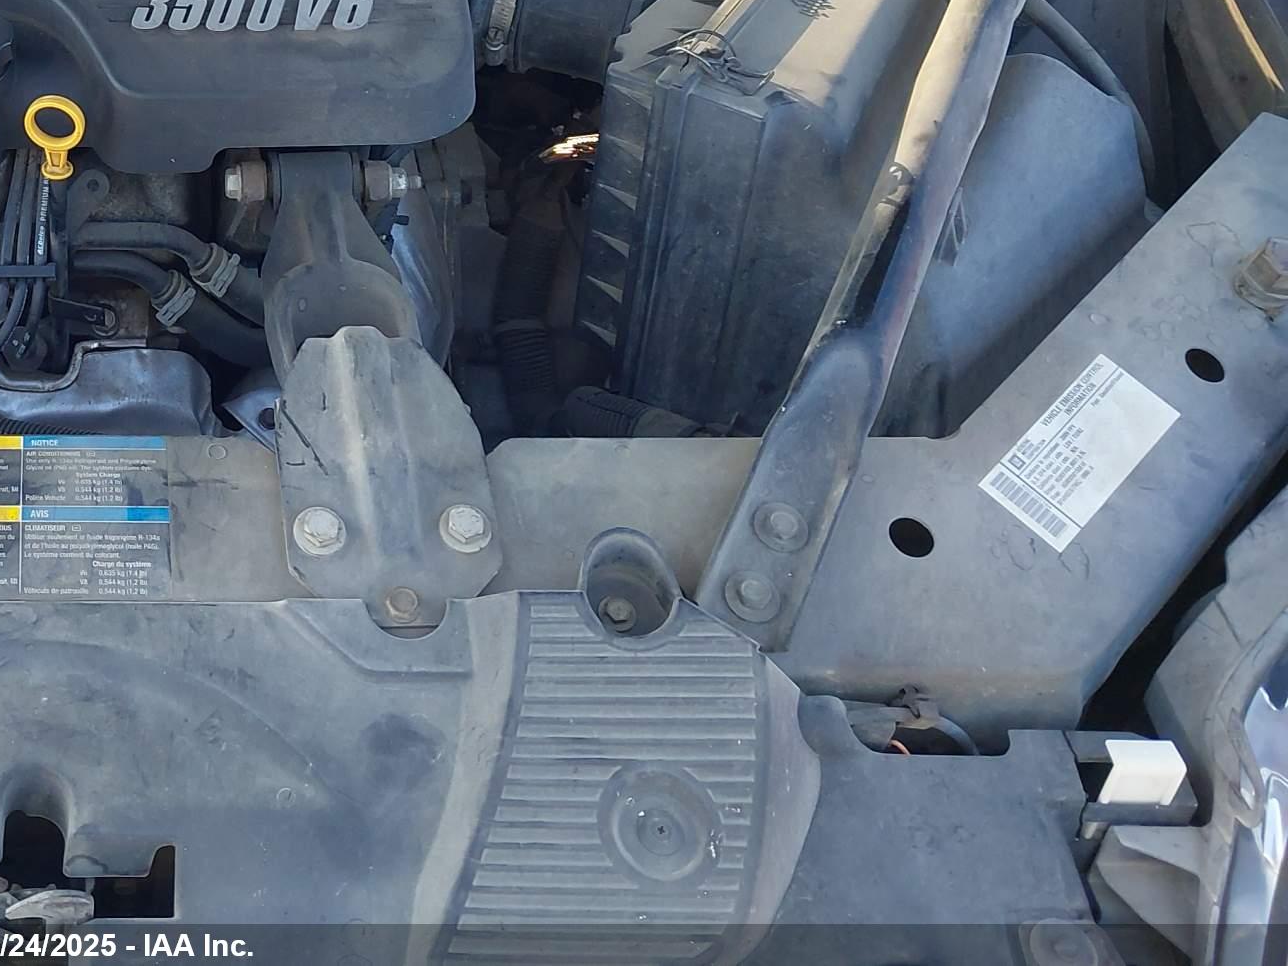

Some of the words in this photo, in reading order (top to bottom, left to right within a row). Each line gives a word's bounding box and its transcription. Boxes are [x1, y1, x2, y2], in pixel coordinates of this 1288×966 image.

[39, 186, 49, 221] PREMIUM
[1040, 406, 1062, 427] VEHICLE
[1060, 384, 1084, 407] EMISSION
[1064, 383, 1096, 416] INFORMATION
[30, 439, 59, 447] NOTICE
[92, 560, 114, 568] Charge
